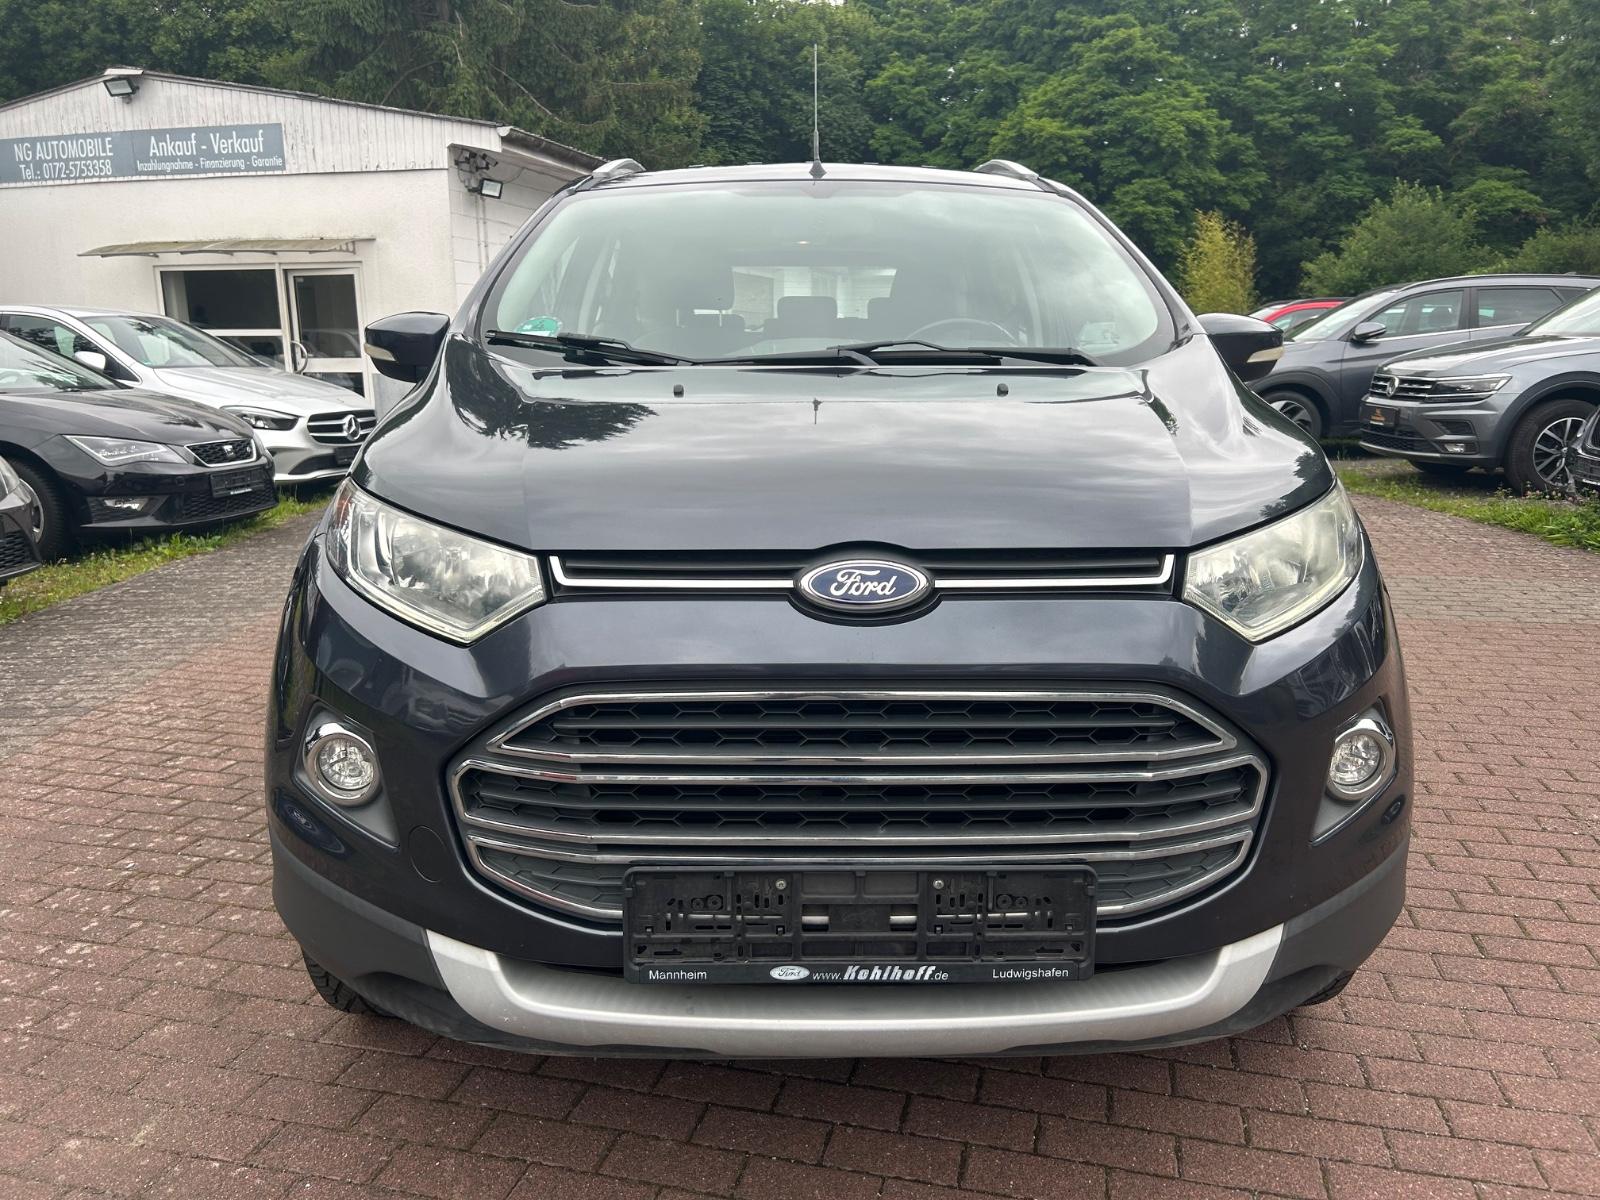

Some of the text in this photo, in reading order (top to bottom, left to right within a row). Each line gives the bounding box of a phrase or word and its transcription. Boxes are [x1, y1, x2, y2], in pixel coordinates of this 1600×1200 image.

[14, 137, 114, 162] NG AUTOMOBILE
[149, 132, 197, 157] Ankauf
[209, 129, 264, 154] Verkauf
[19, 160, 113, 180] Tel.: 0172-5753358
[200, 157, 245, 169] Finanzierung
[251, 155, 283, 168] Garantie
[830, 569, 898, 596] Ford
[649, 970, 708, 980] Mannheim
[778, 967, 801, 978] Ford
[992, 967, 1070, 980] Ludwigshafen
